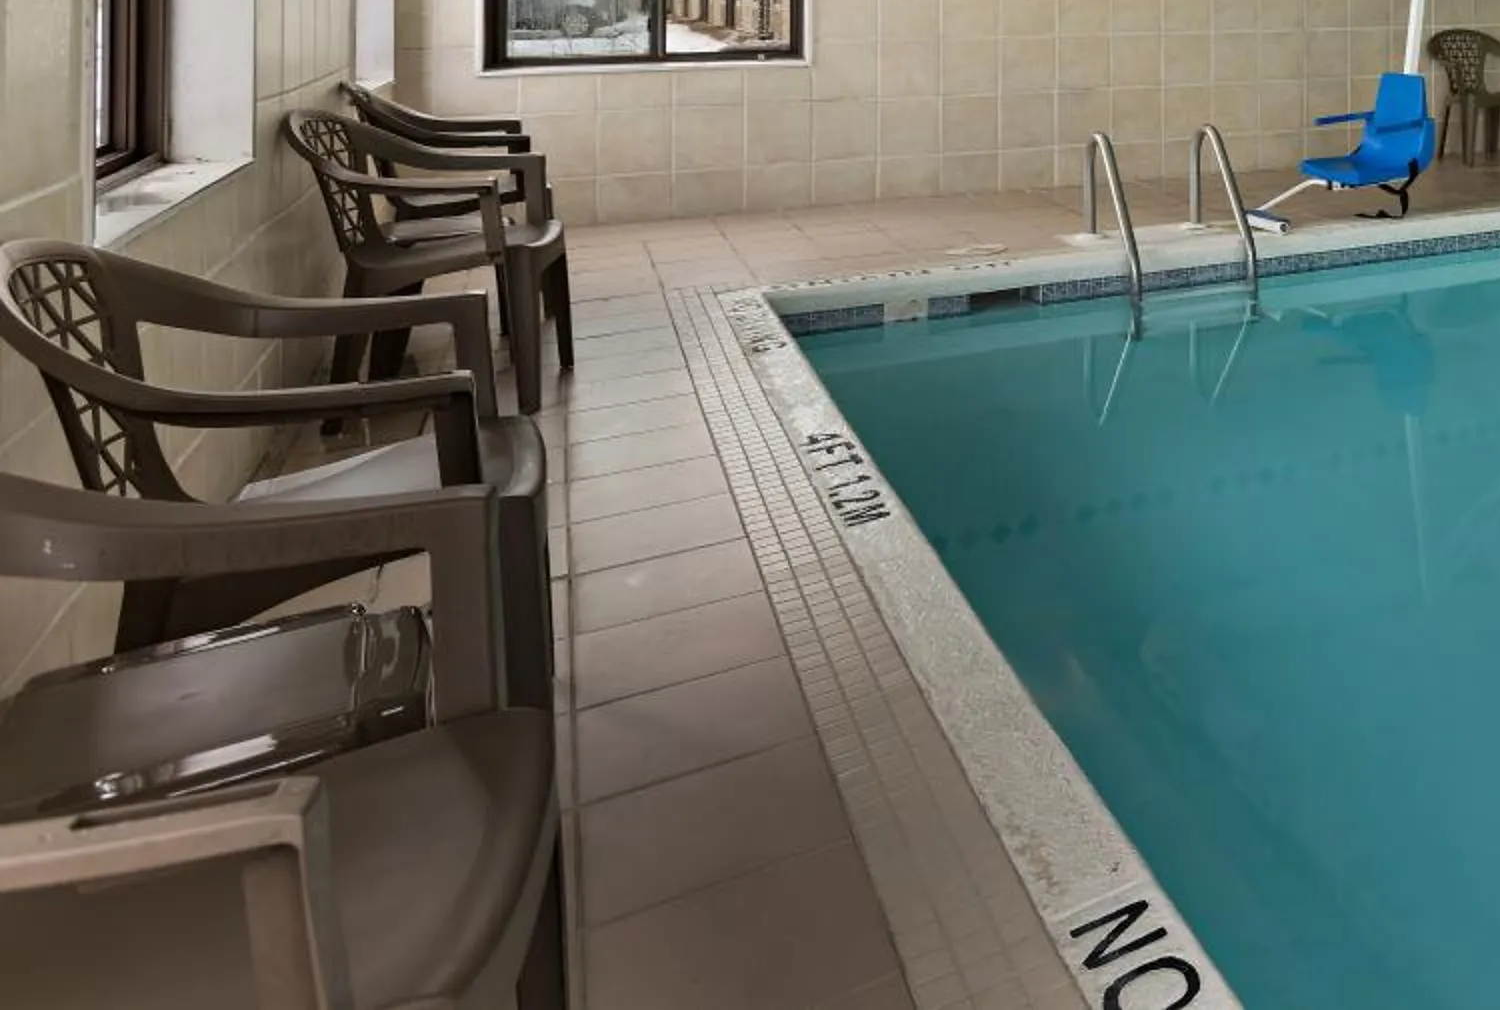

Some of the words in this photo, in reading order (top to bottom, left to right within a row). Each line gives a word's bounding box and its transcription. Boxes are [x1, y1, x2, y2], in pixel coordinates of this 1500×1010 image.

[800, 432, 864, 471] 4FT
[828, 474, 891, 528] 1.2M
[1069, 899, 1201, 1010] NO
